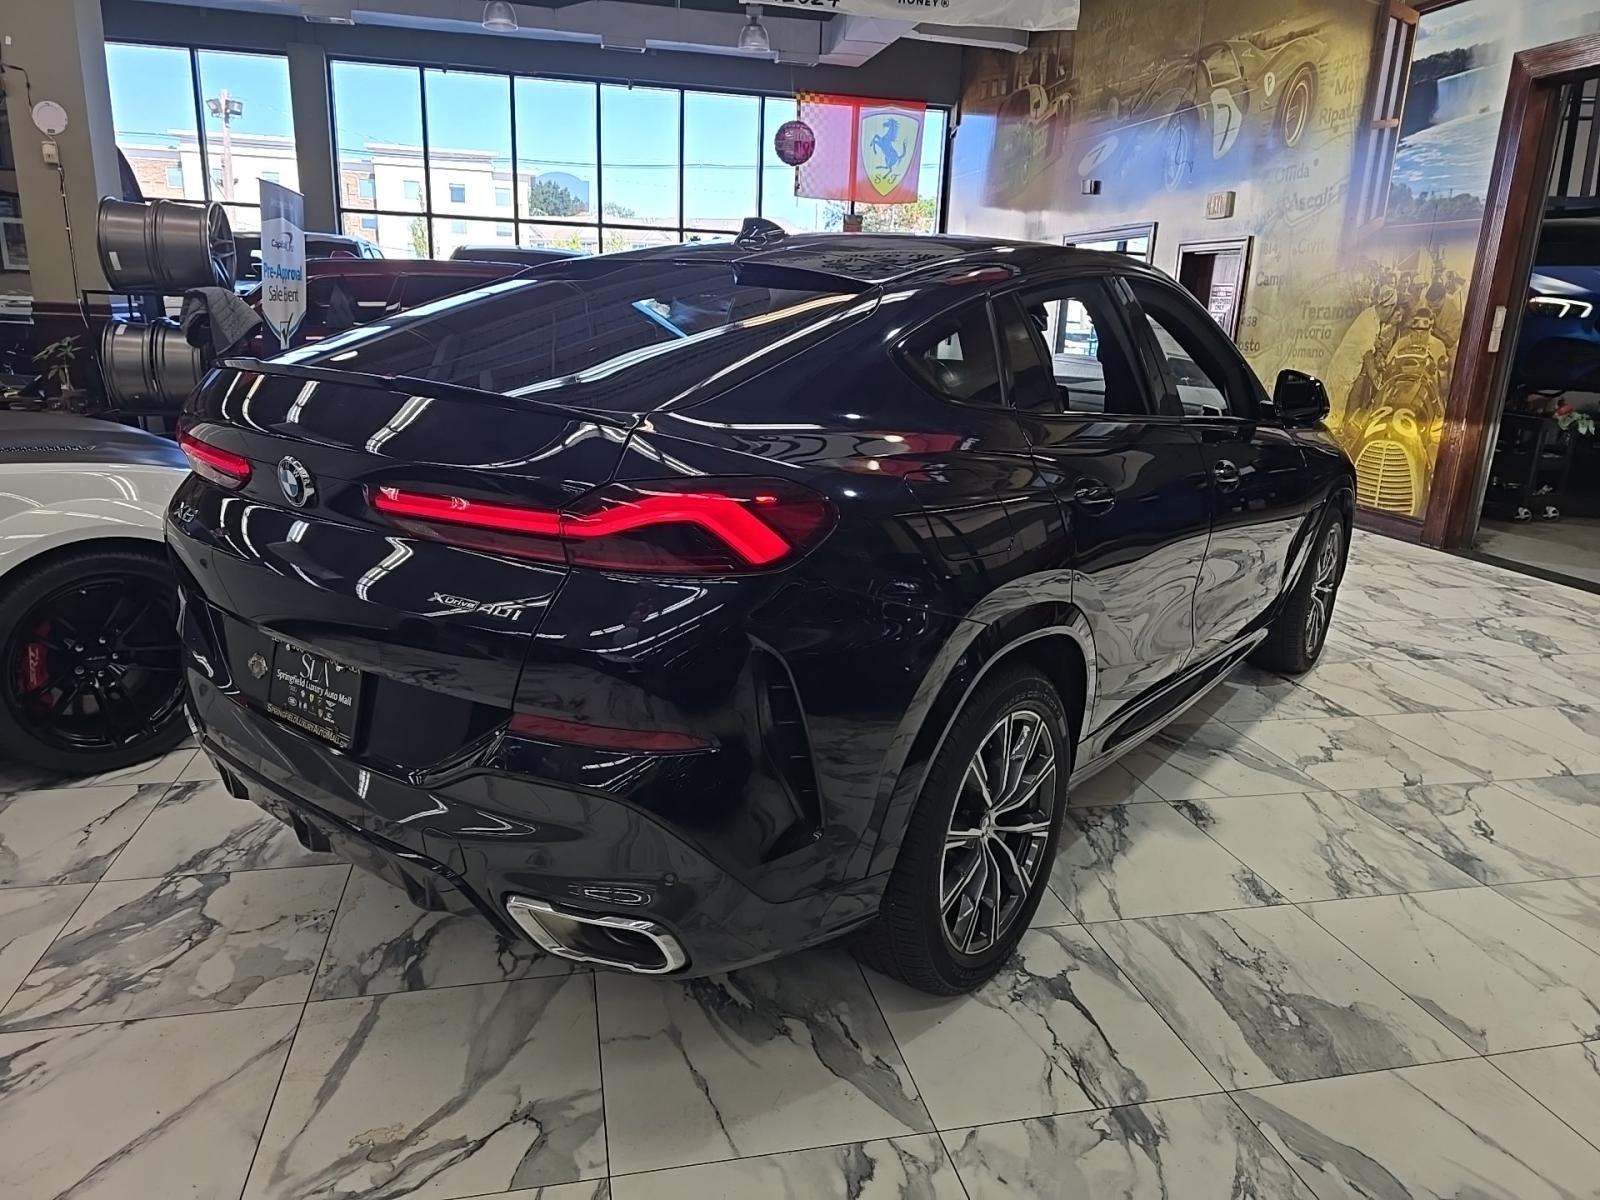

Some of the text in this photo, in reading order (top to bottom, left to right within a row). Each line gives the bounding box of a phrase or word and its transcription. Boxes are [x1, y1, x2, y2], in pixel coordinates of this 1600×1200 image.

[263, 262, 303, 283] Pre-Approval
[268, 285, 283, 302] Sale
[1364, 406, 1418, 439] 26
[324, 687, 339, 701] Auto
